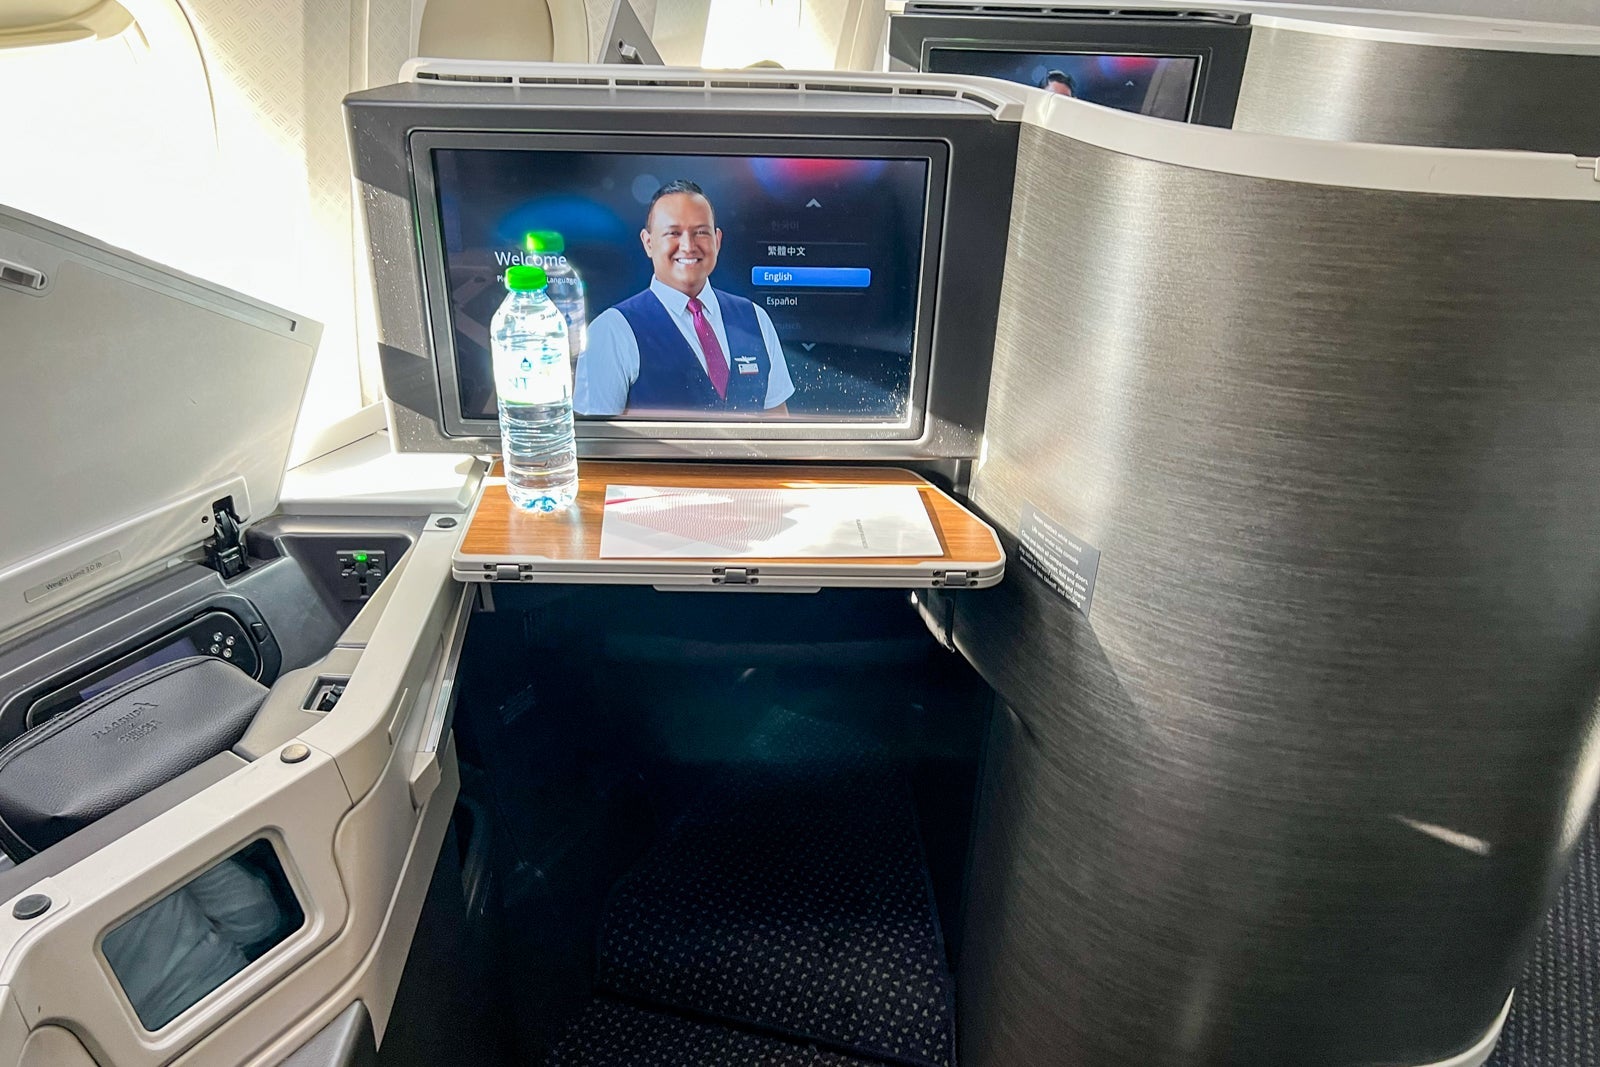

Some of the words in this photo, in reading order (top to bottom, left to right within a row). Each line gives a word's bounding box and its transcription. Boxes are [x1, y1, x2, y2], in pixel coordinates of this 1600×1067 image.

[767, 245, 806, 257] 繁體中文
[494, 251, 567, 266] Welcome
[546, 276, 578, 286] Language
[763, 271, 793, 283] English
[766, 296, 798, 307] Español
[45, 576, 69, 590] Weight
